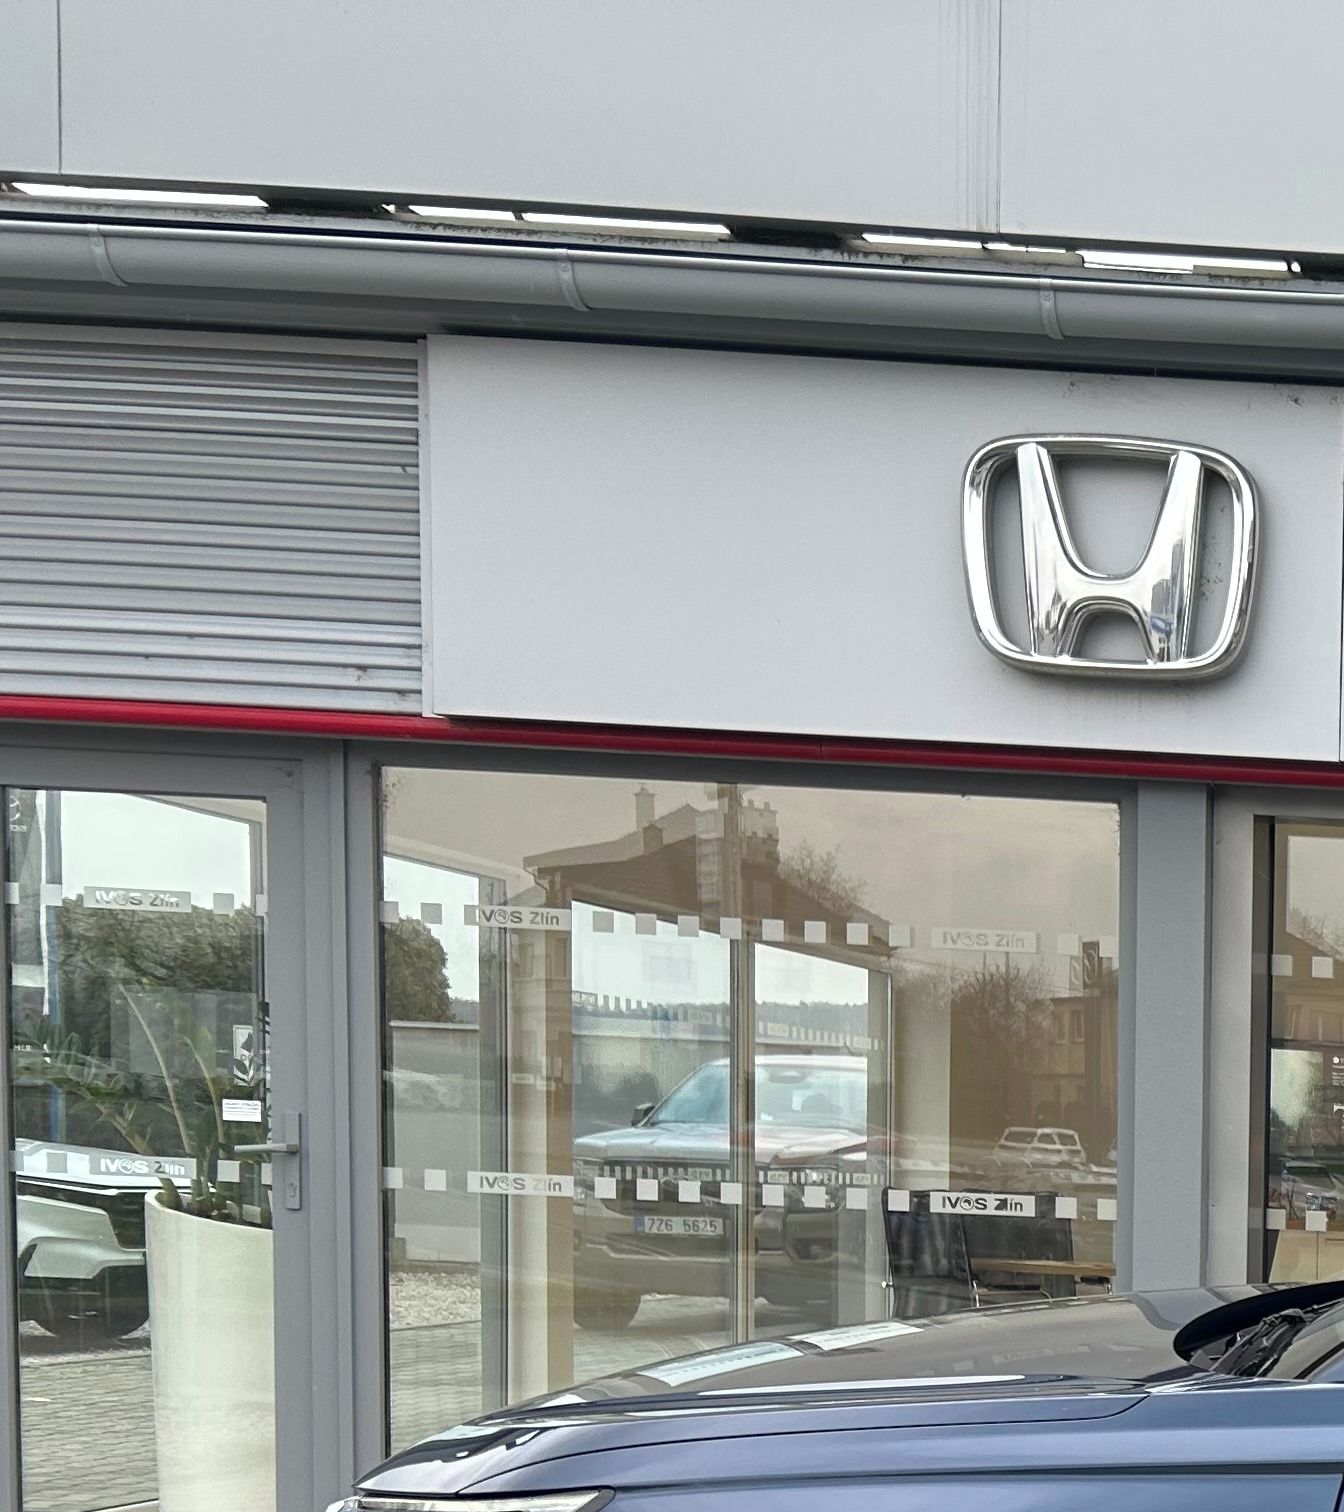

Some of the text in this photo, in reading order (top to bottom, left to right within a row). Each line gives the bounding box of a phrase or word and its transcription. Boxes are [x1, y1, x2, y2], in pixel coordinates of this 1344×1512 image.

[530, 911, 560, 926] Zlín
[943, 931, 989, 946] IVOS
[101, 1158, 149, 1173] IVOS
[479, 1176, 526, 1191] IVOS
[942, 1196, 988, 1211] IVOS
